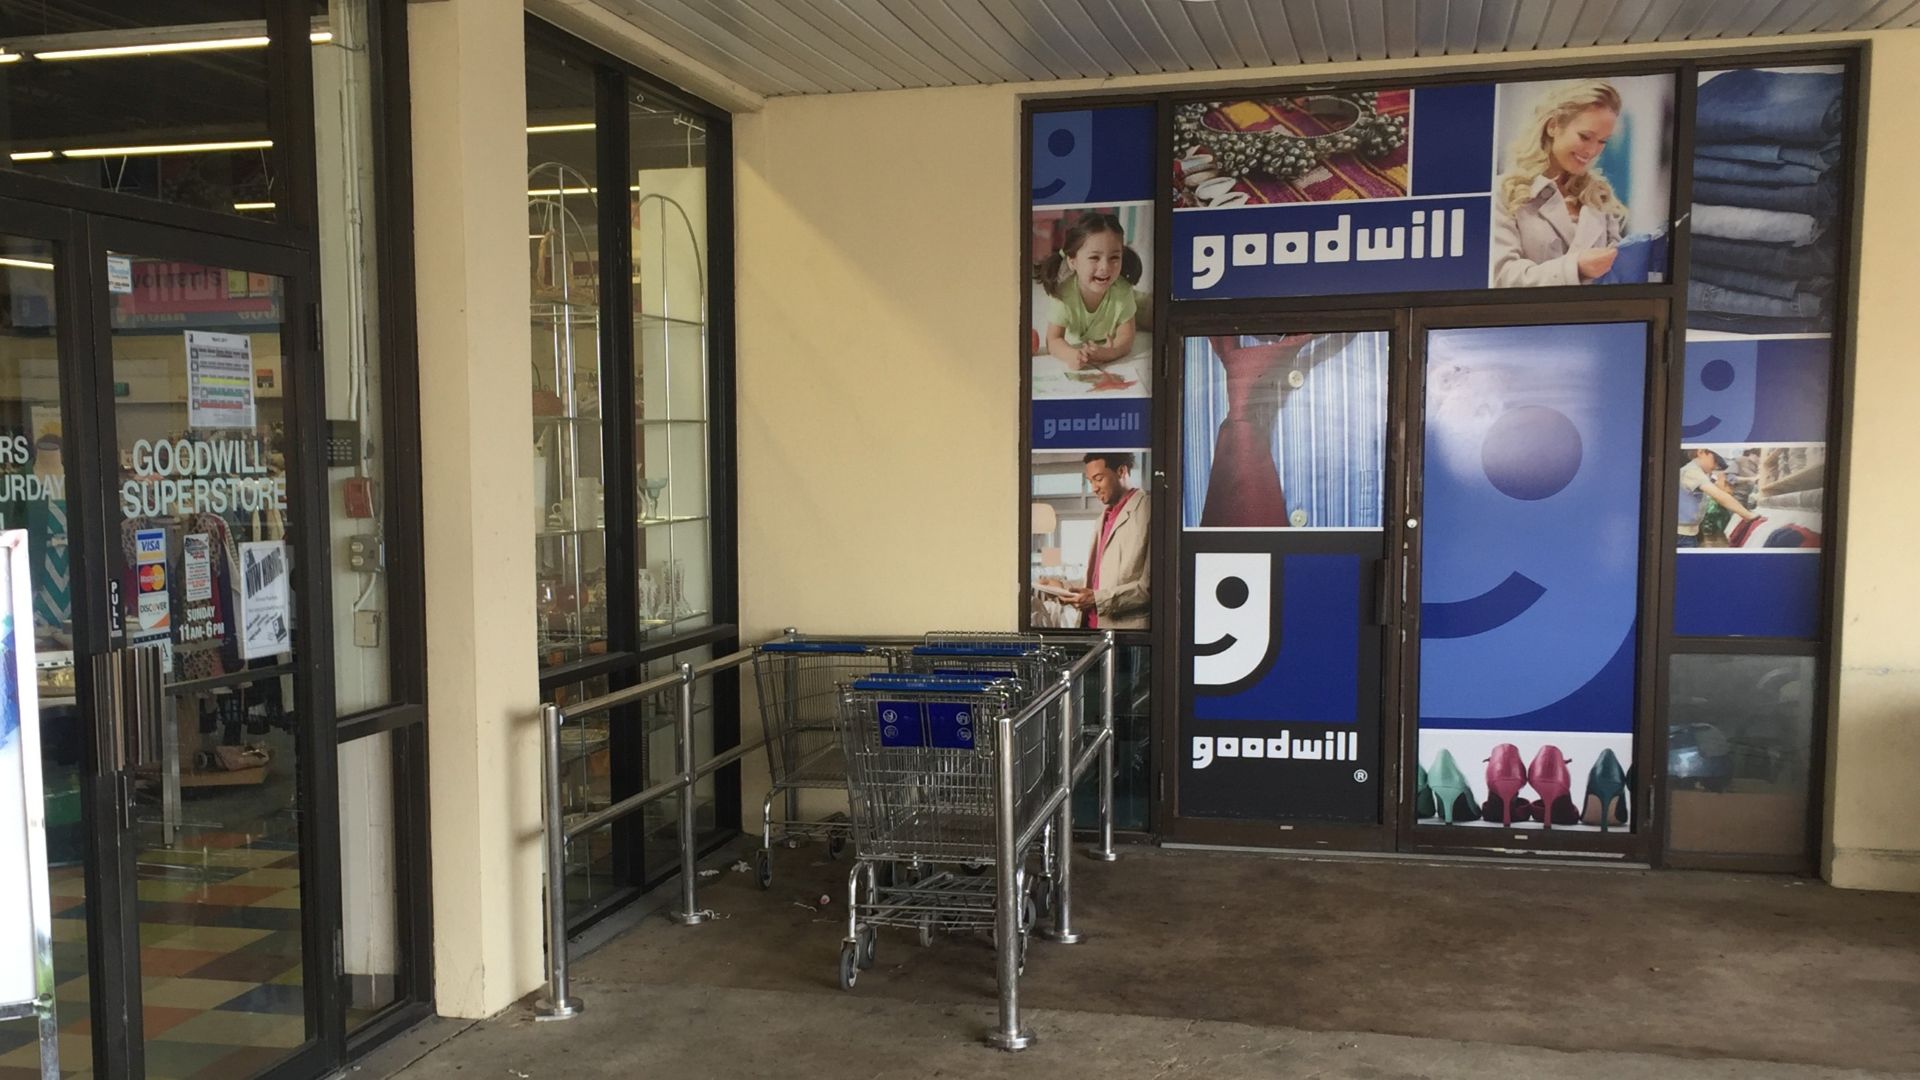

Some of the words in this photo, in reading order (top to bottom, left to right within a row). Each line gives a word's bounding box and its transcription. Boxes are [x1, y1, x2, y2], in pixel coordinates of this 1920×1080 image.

[1192, 208, 1465, 290] goodwill
[1044, 413, 1139, 439] goodwill
[133, 439, 267, 476] GOODWILL
[123, 477, 287, 518] SUPERSTORE
[141, 540, 160, 551] VISA
[111, 581, 119, 629] PULL
[140, 601, 167, 613] DISCOVER
[187, 605, 216, 621] SUNDAY
[1193, 730, 1358, 769] goodwill
